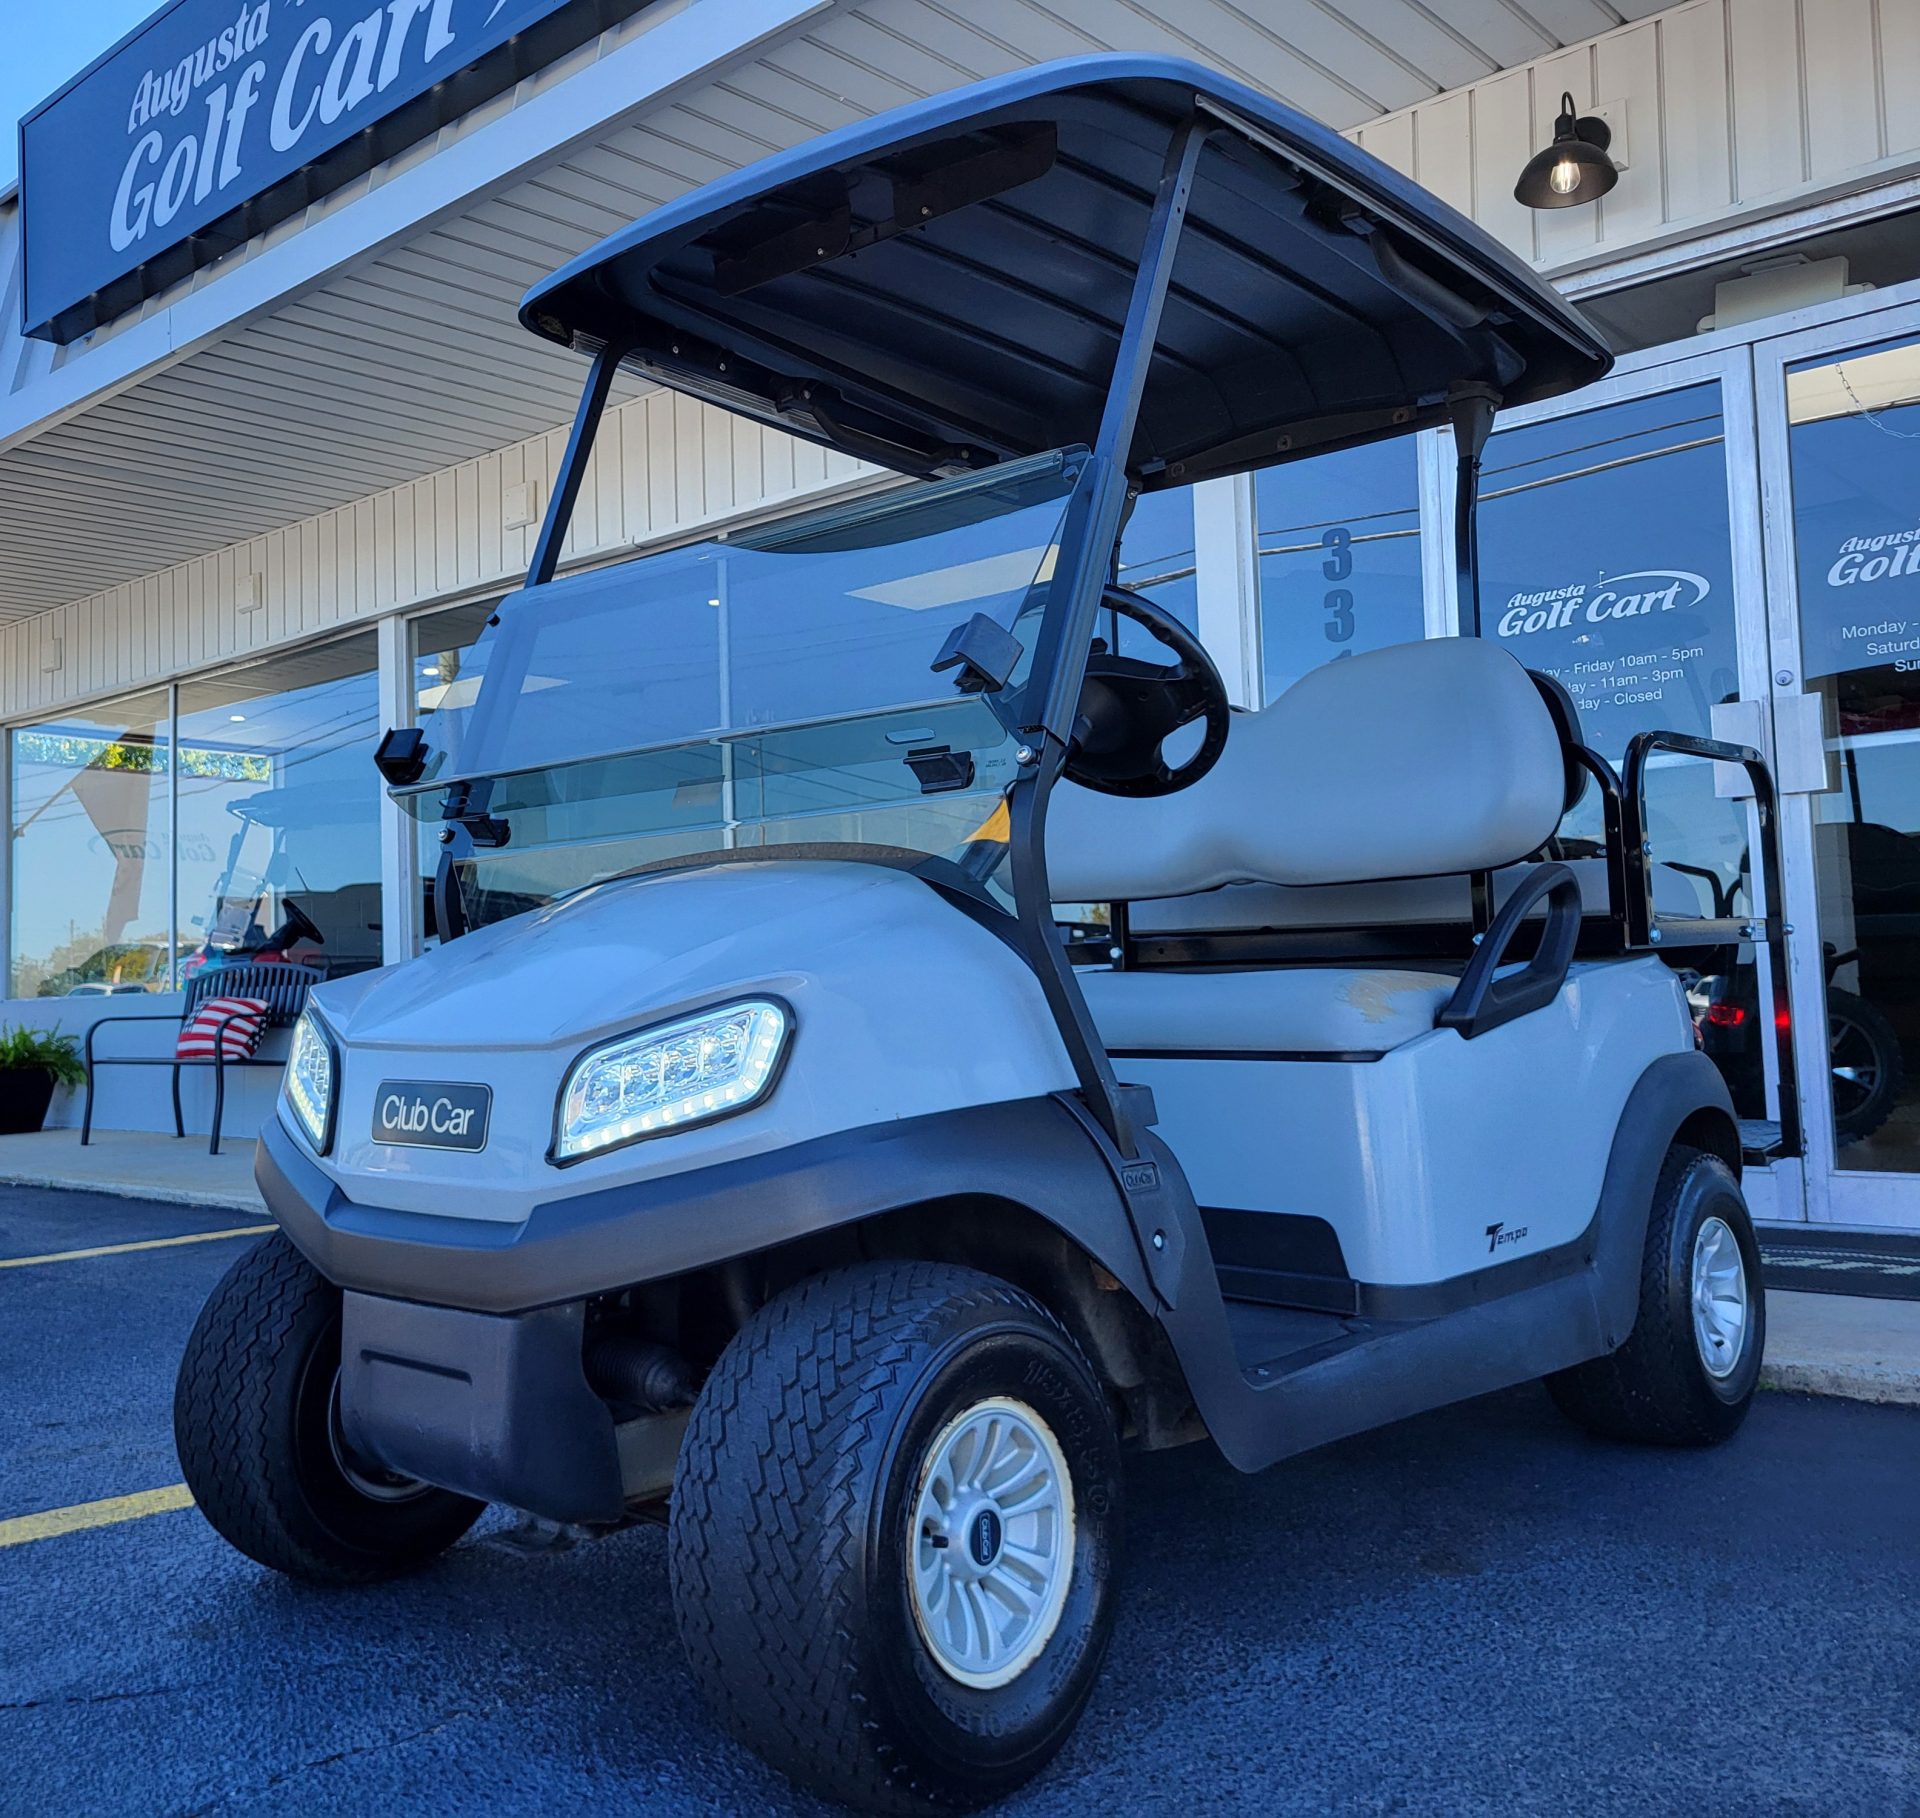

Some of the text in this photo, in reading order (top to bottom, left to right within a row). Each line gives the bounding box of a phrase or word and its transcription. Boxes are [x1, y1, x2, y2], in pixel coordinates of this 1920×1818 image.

[127, 0, 271, 135] Augusta
[109, 60, 266, 253] Golf
[1497, 580, 1682, 637] Golf Cart
[1506, 583, 1586, 608] Augusta
[1841, 620, 1907, 640] Monday
[1573, 660, 1615, 675] Friday
[1619, 654, 1657, 668] 10am
[1671, 646, 1704, 663] 5pm
[1865, 636, 1920, 656] Saturd
[1600, 674, 1638, 688] 11am
[1651, 668, 1684, 684] 3pm
[1614, 687, 1663, 706] Closed
[382, 1094, 475, 1136] Club Car
[1485, 1221, 1528, 1253] Tempo
